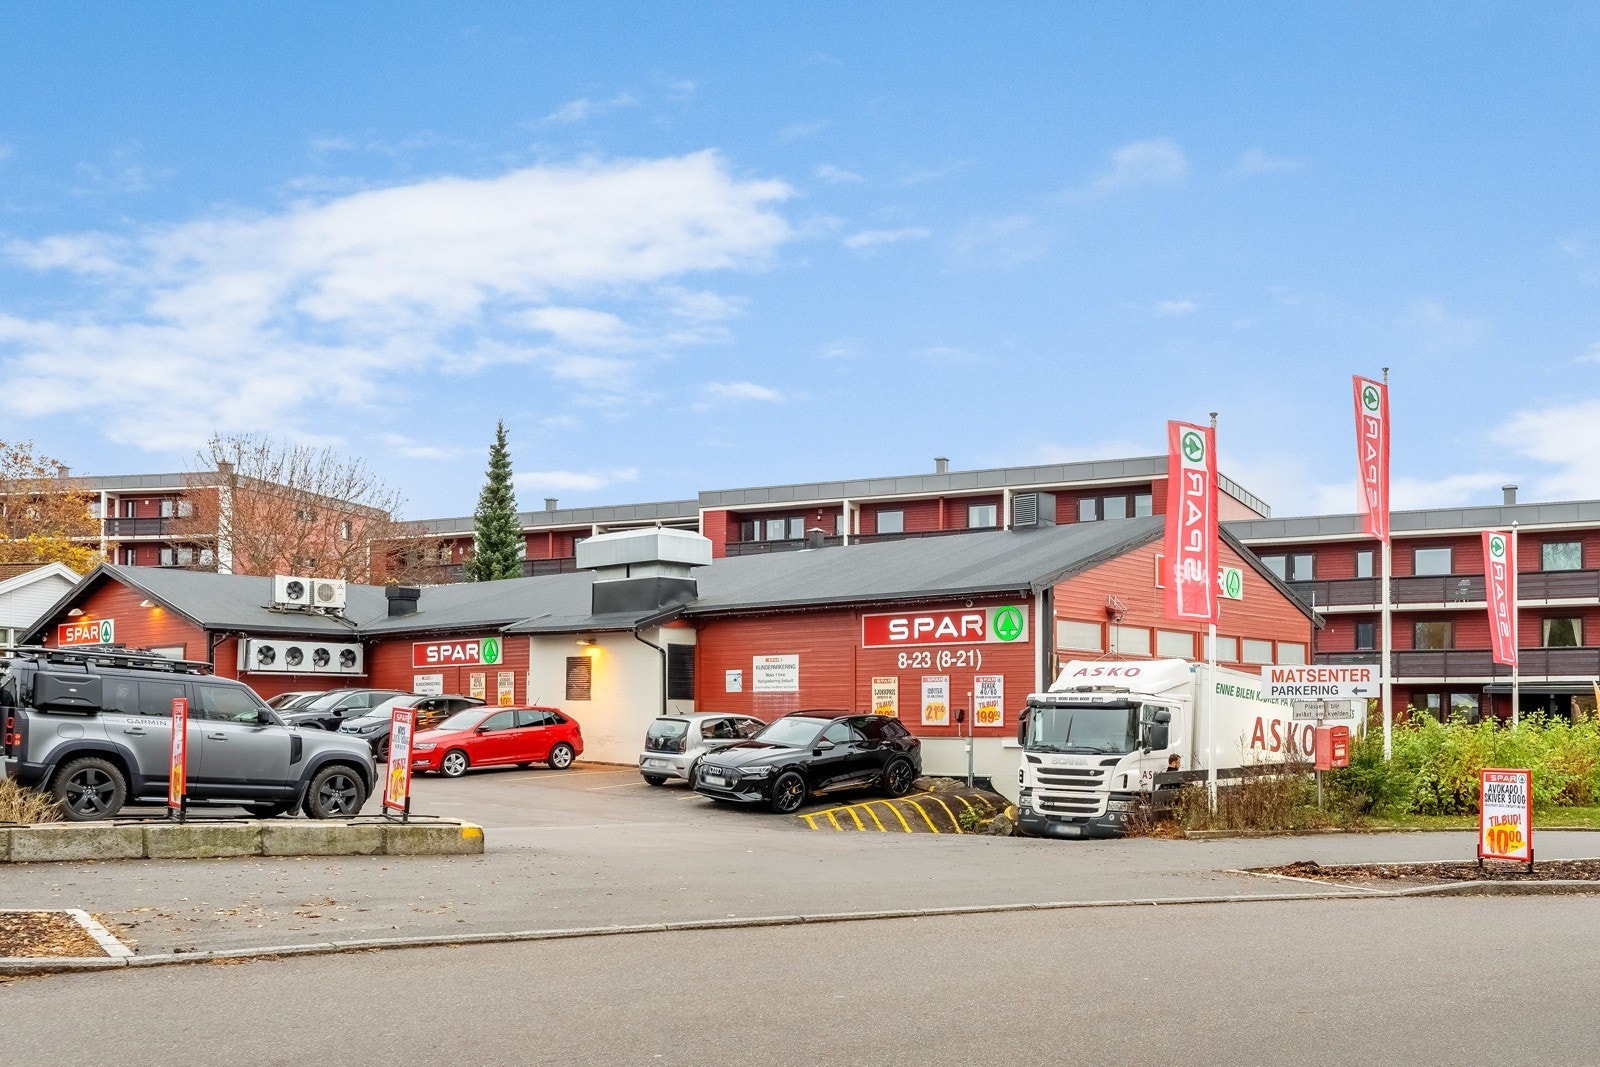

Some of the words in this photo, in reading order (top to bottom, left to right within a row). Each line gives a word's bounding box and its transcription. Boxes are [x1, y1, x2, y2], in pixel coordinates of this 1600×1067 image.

[66, 625, 99, 642] SPAR
[888, 614, 984, 641] SPAR
[426, 643, 479, 662] SPAR
[897, 651, 931, 669] 8-23
[936, 649, 982, 671] (8-21)
[1072, 667, 1141, 677] ASKO
[1271, 668, 1370, 683] MATSENTER
[1235, 686, 1255, 700] BILEN
[1271, 685, 1339, 696] PARKERING
[126, 718, 167, 726] GARMIN
[1250, 716, 1316, 757] ASKO
[1051, 757, 1088, 766] SCANIA
[1490, 774, 1517, 782] SPAR
[1487, 783, 1519, 795] AVOKADO
[1484, 792, 1506, 804] SKIVER
[1508, 794, 1526, 805] 300G
[1488, 813, 1522, 827] TILBUD!
